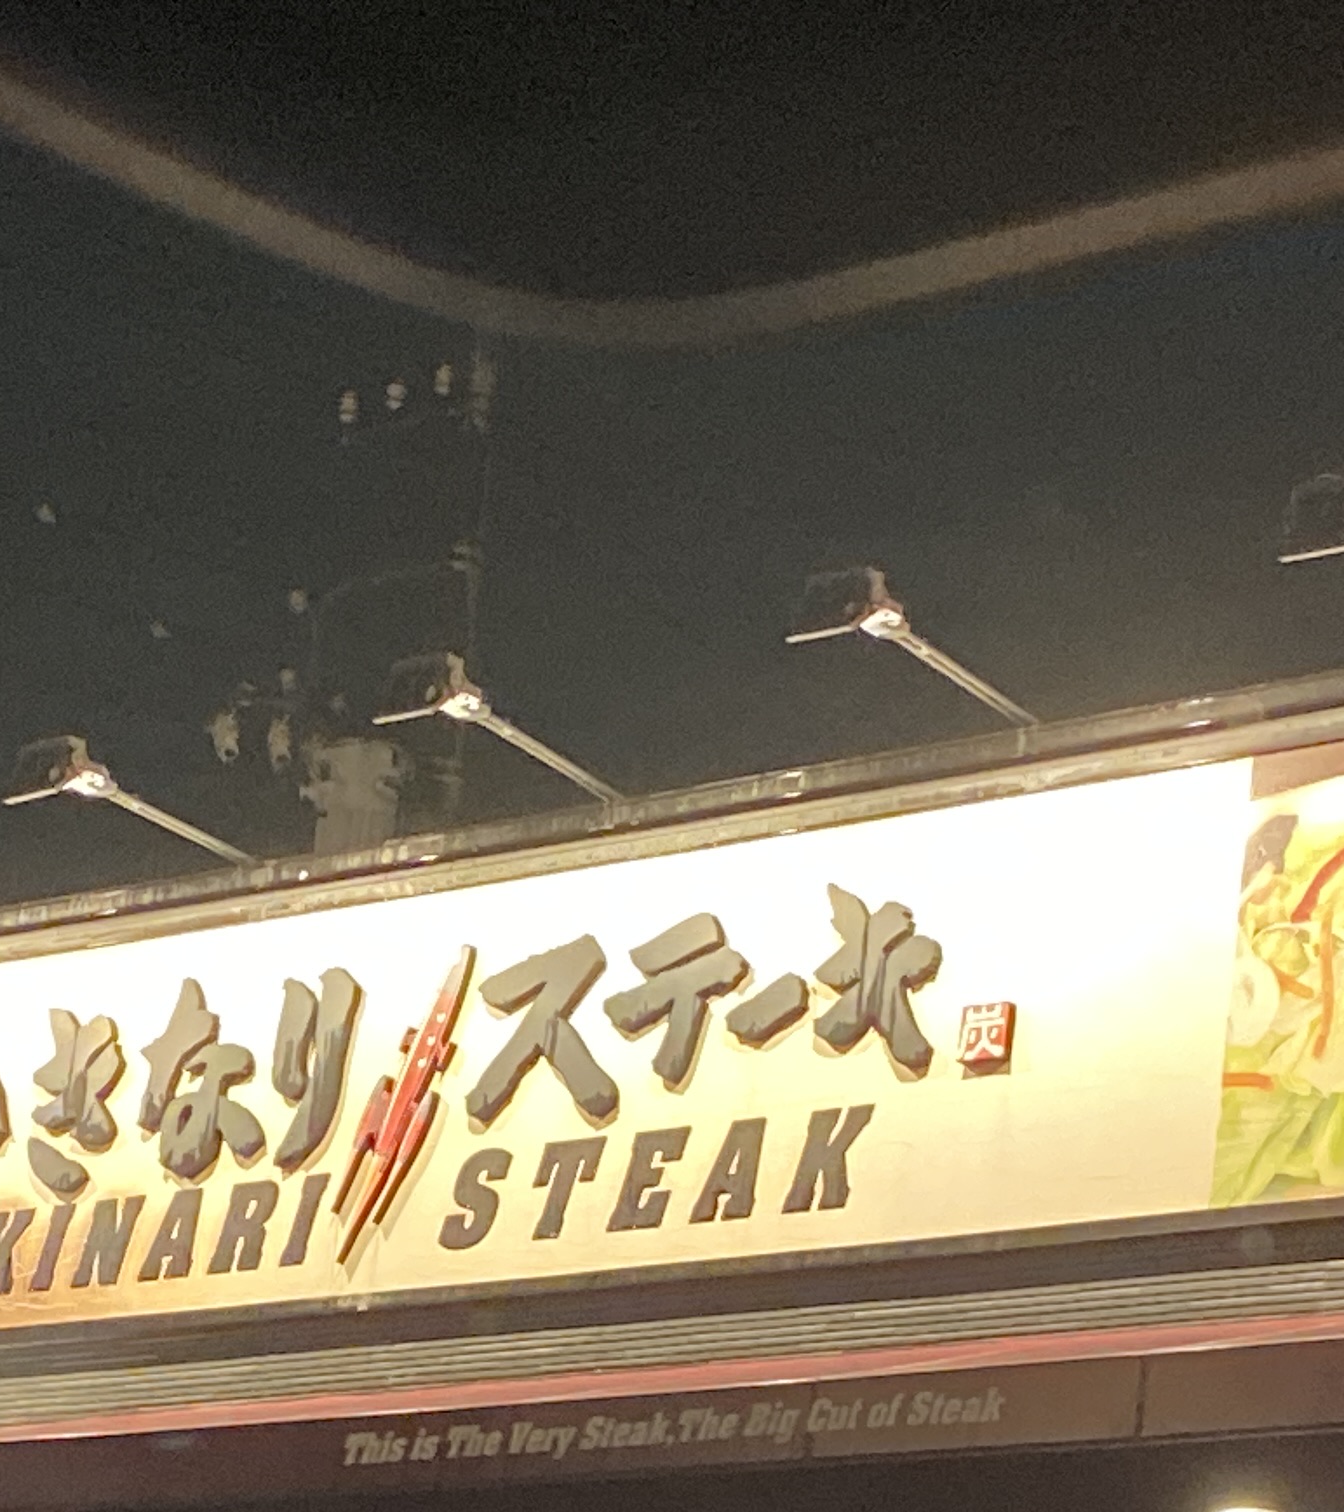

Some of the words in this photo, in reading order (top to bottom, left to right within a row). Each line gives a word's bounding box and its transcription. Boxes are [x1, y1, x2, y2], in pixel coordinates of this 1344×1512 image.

[439, 1104, 874, 1251] STEAK
[344, 1430, 408, 1466] This
[409, 1427, 439, 1461] is
[447, 1424, 503, 1458] The
[508, 1421, 576, 1460] Very
[678, 1406, 740, 1444] The
[744, 1400, 801, 1444] Big
[807, 1397, 864, 1432] Cut
[867, 1392, 905, 1428] of
[907, 1387, 1005, 1428] Steak
